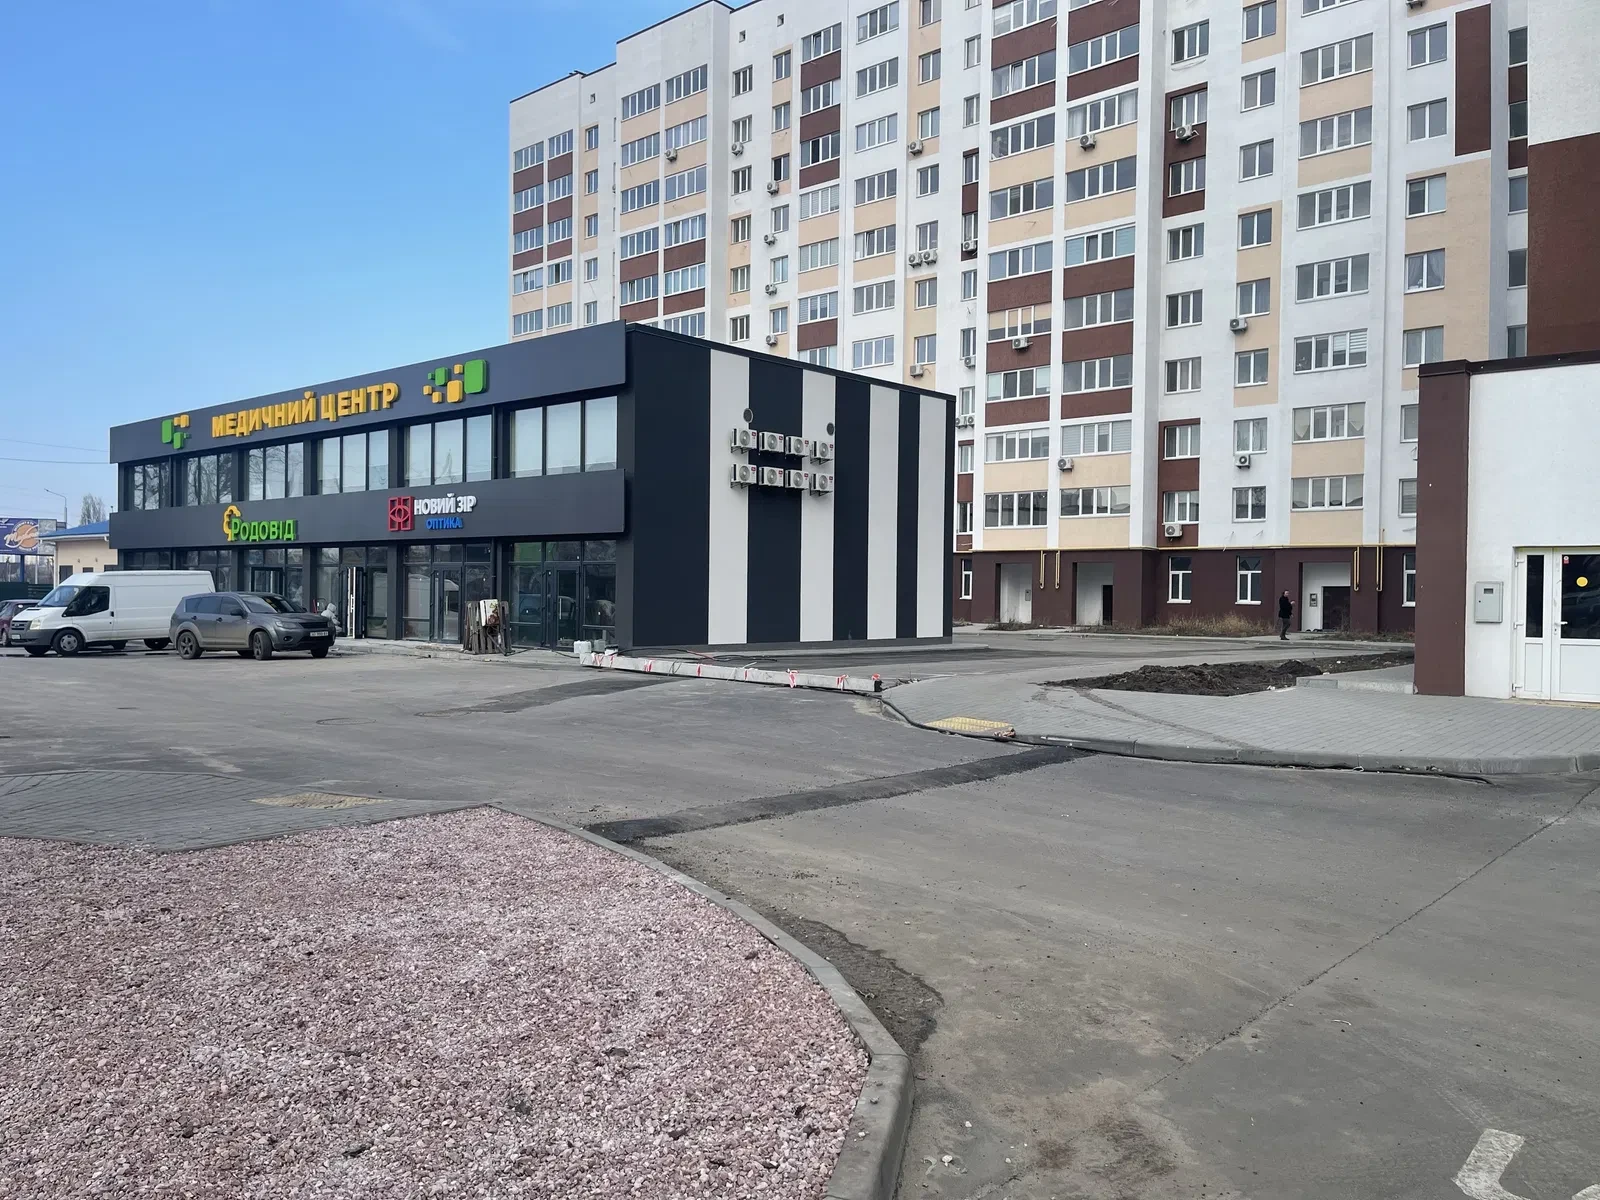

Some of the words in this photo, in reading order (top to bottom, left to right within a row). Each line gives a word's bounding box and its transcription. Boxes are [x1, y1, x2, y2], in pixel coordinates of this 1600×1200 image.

[212, 391, 316, 437] МЕДИЧНИЙ
[320, 382, 399, 422] ЦЕНТР
[414, 493, 456, 515] НОВИЙ
[457, 495, 477, 513] ЗІР
[426, 517, 463, 529] ОПТИКА
